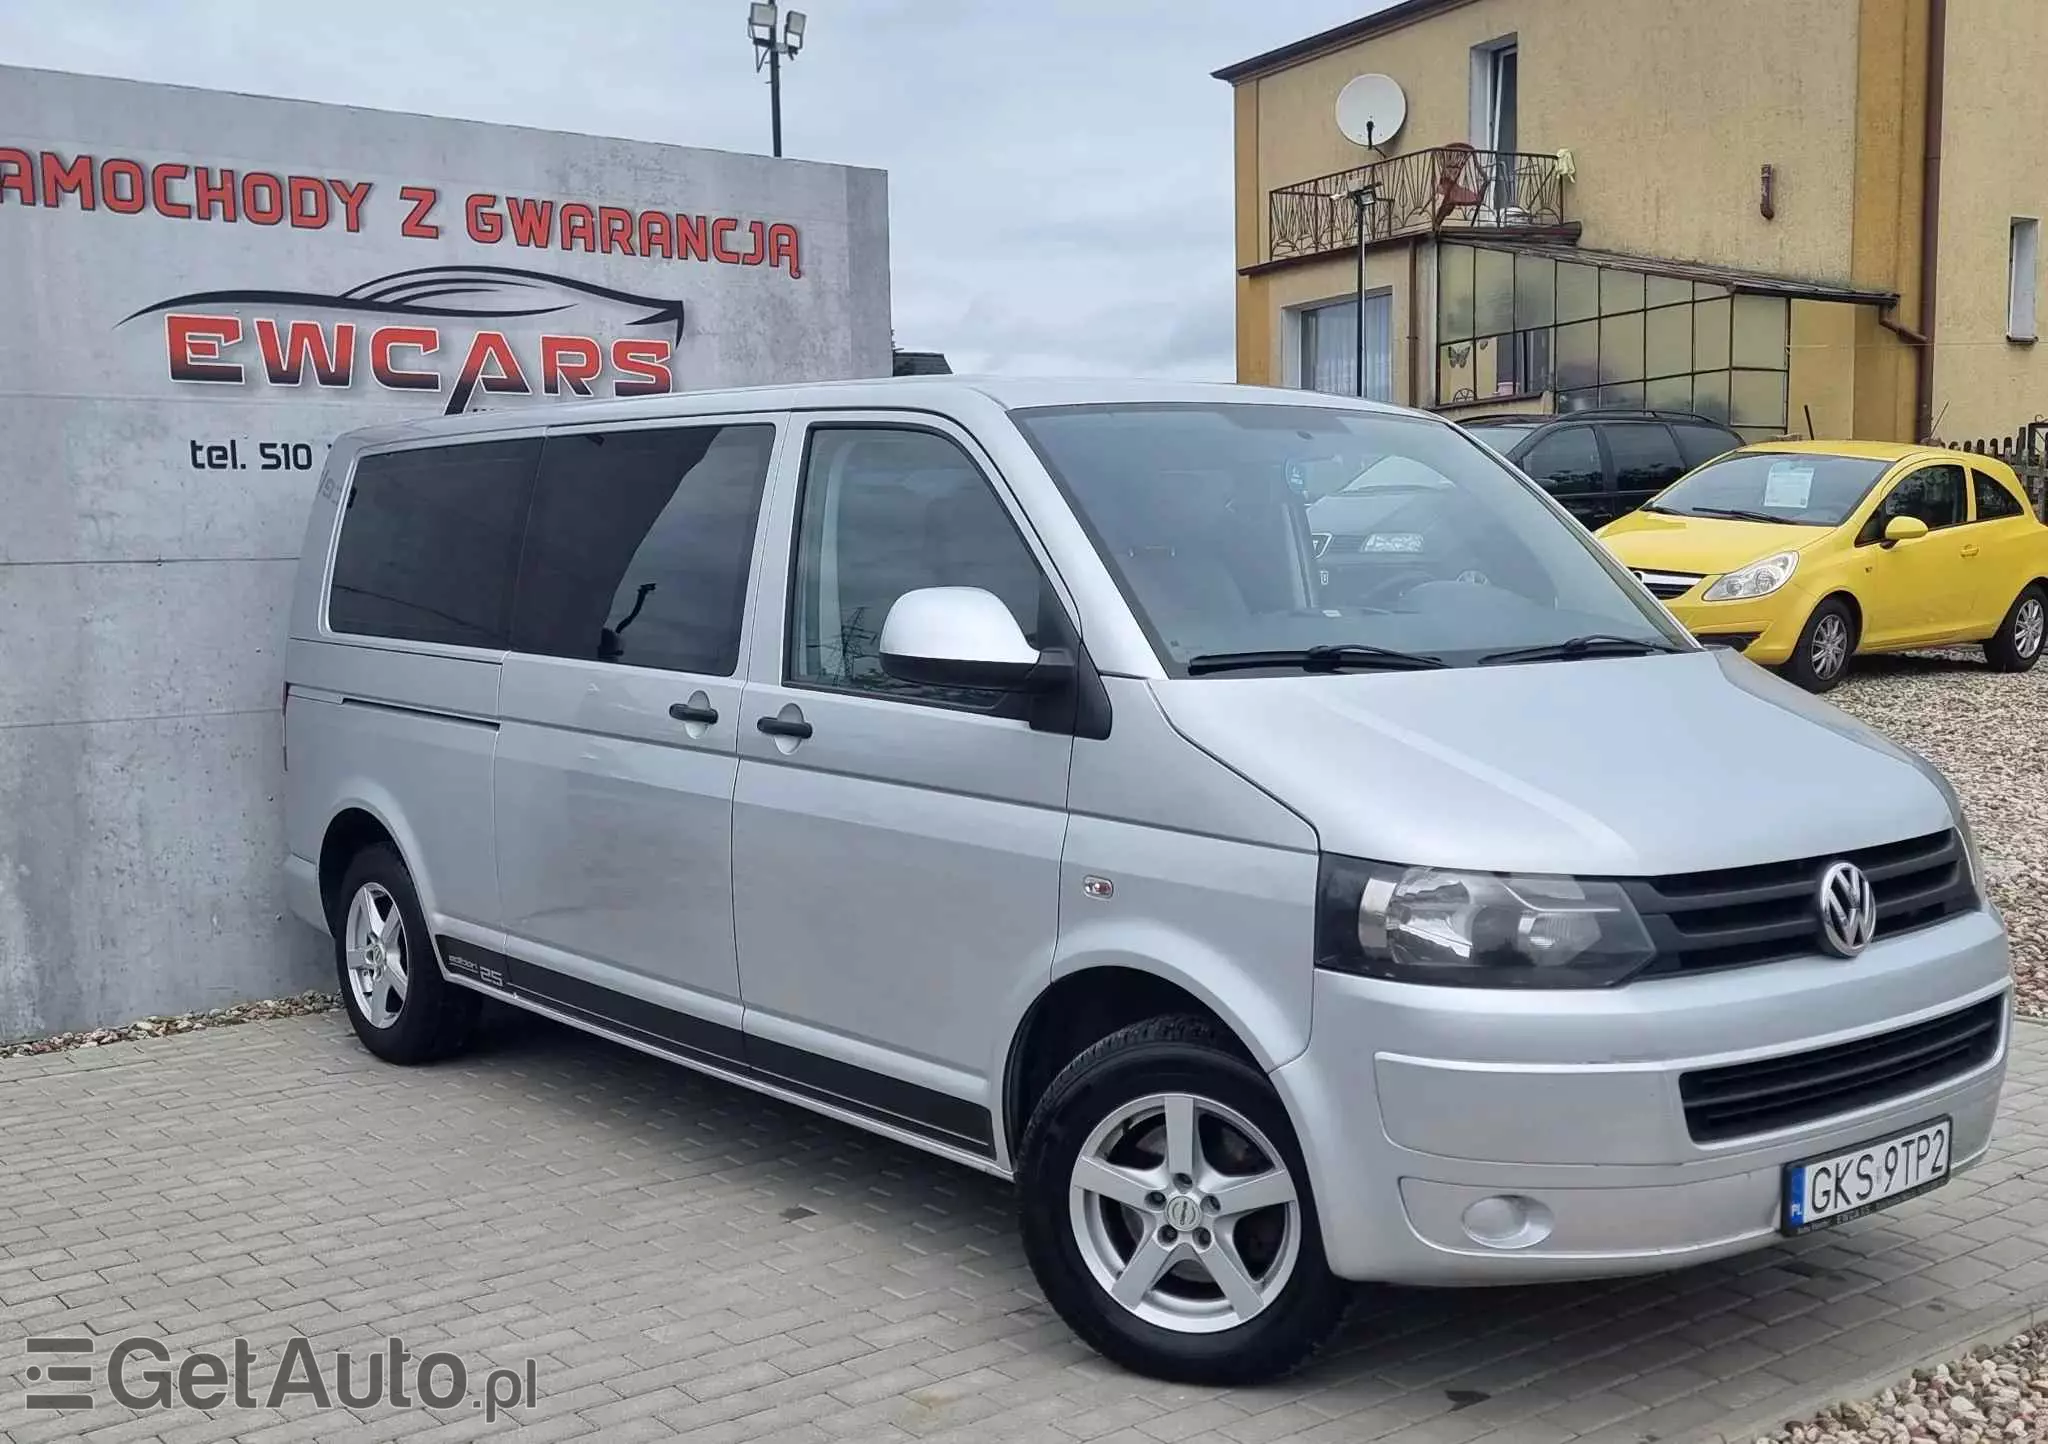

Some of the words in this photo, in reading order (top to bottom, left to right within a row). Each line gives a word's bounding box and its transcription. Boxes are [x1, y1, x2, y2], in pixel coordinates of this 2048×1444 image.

[400, 185, 440, 239] Z
[465, 193, 801, 279] GWARANCJĄ
[165, 313, 674, 416] EWCARS
[190, 439, 247, 470] tel.
[259, 442, 313, 471] 510
[479, 965, 504, 987] 25
[1811, 1154, 1875, 1215] GKS
[1884, 1129, 1945, 1194] 9TP2
